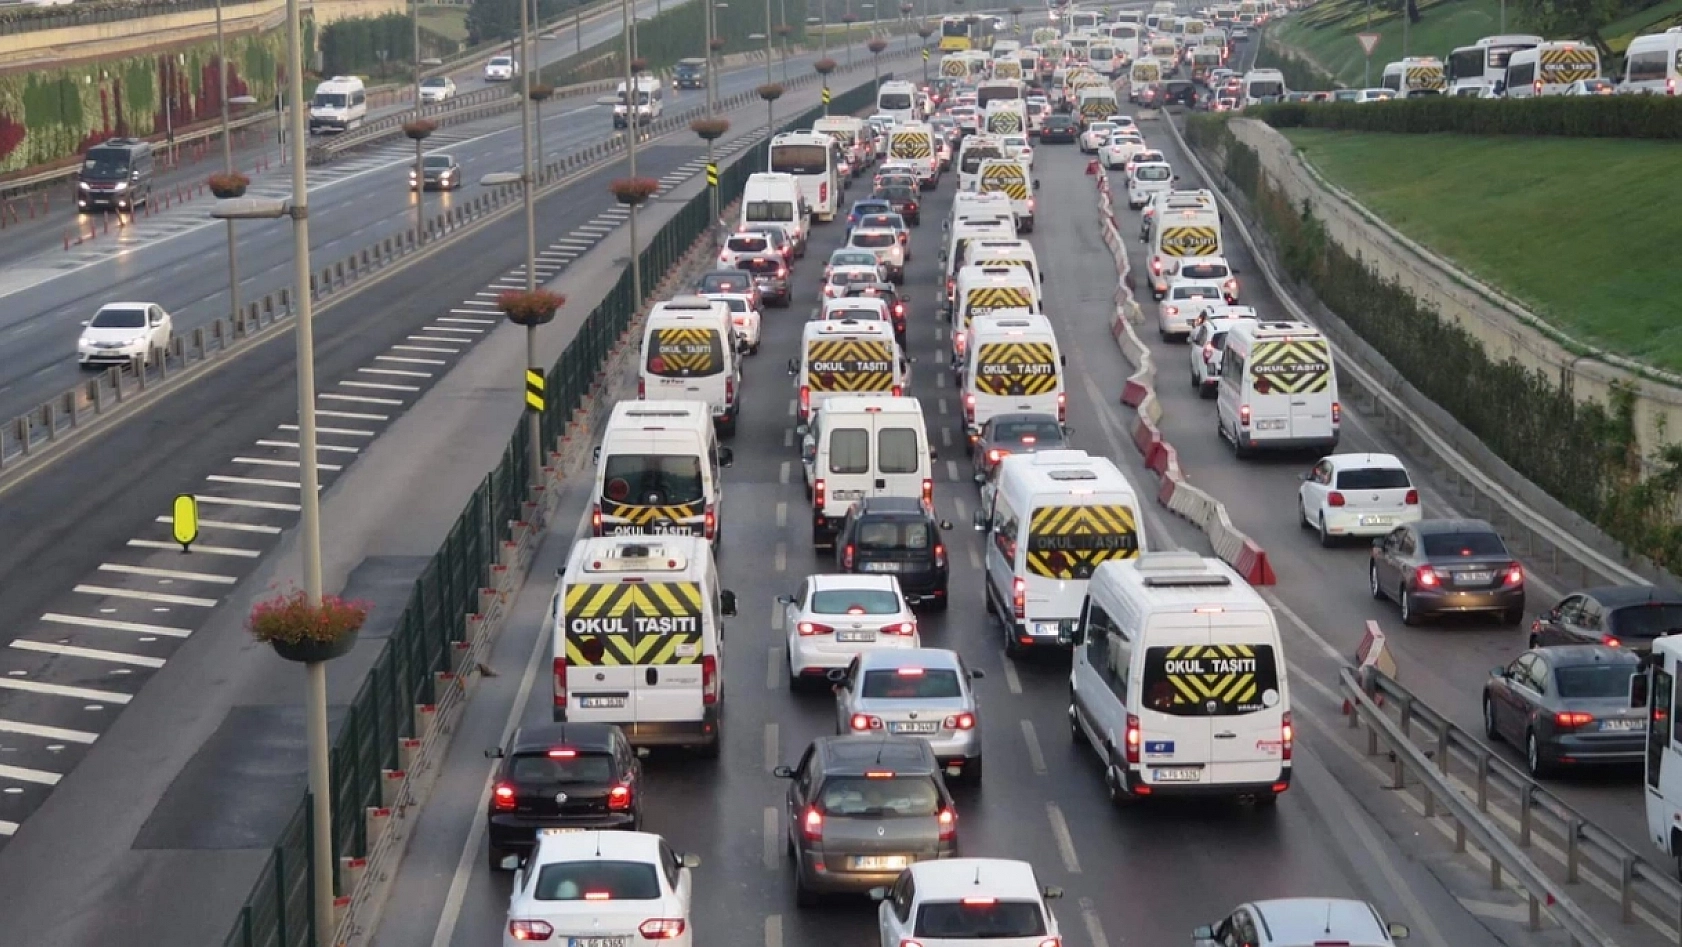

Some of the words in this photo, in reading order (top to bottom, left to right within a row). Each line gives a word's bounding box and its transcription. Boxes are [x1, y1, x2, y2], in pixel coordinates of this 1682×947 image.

[815, 361, 845, 371] OKUL
[858, 361, 888, 373] TAŞITI
[983, 364, 1010, 375] OKUL
[1018, 363, 1051, 377] TAŞITI
[1255, 365, 1286, 373] OKUL
[614, 526, 645, 536] OKUL
[1037, 539, 1076, 553] OKUL
[572, 617, 628, 633] OKUL
[635, 616, 696, 636] TAŞITI
[1165, 659, 1204, 674] OKUL
[1212, 658, 1256, 676] TAŞITI
